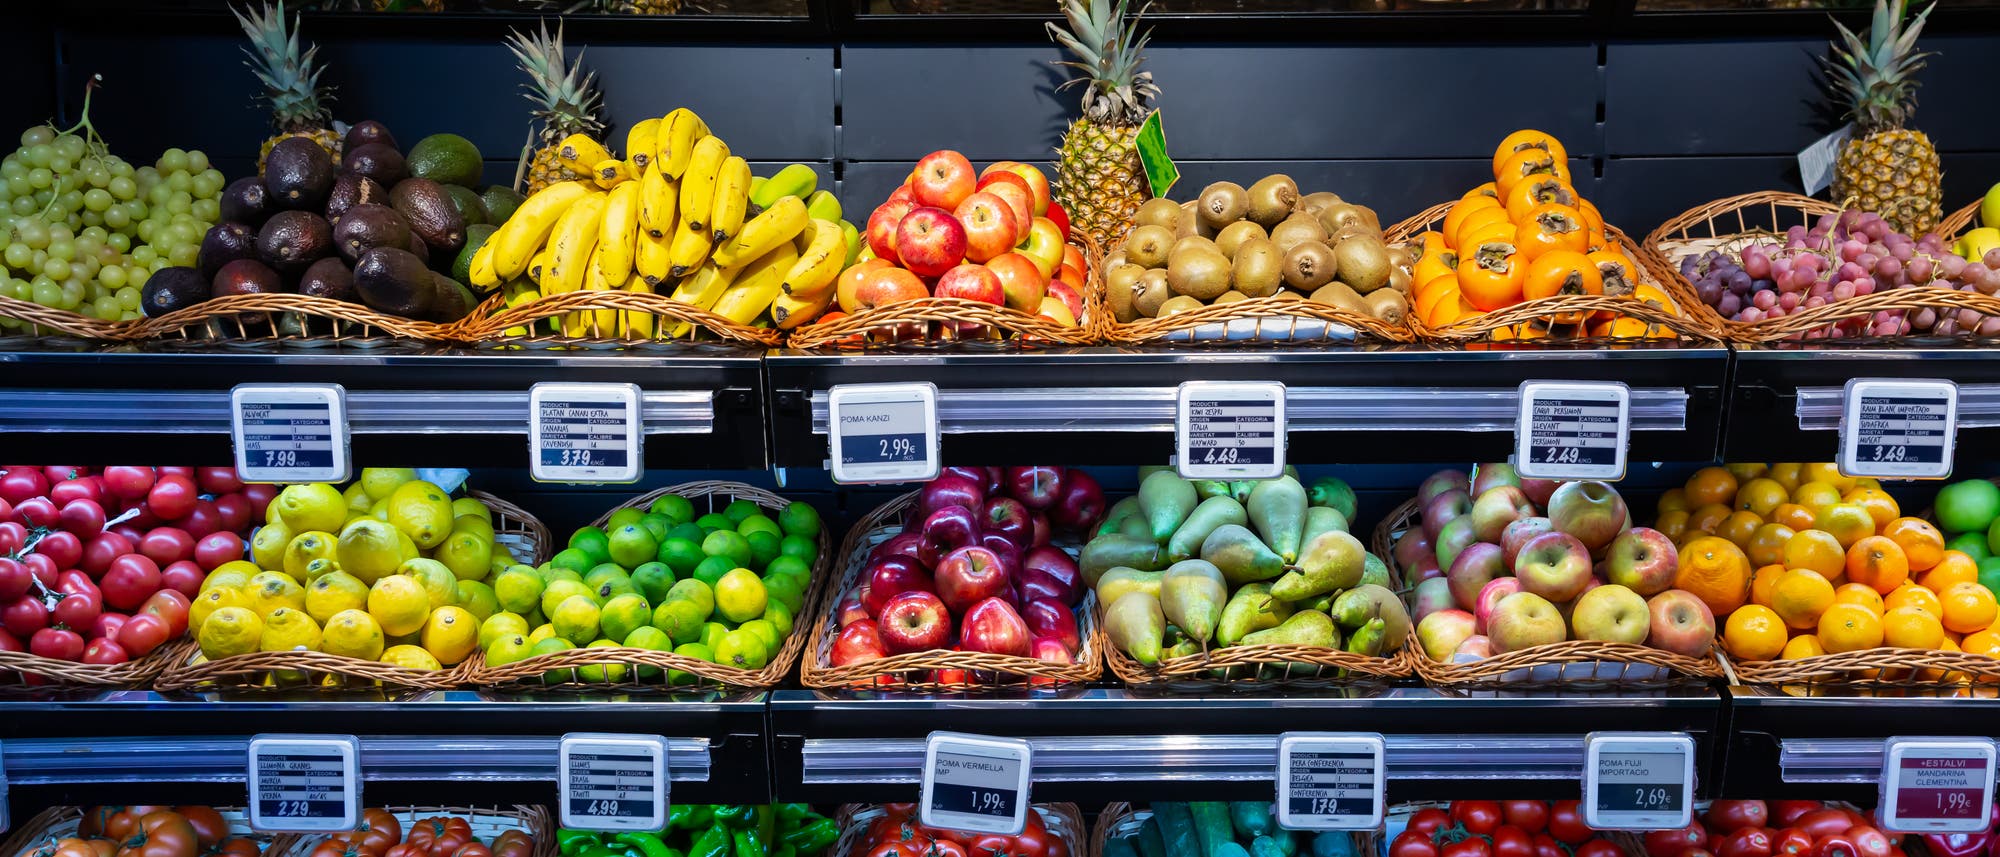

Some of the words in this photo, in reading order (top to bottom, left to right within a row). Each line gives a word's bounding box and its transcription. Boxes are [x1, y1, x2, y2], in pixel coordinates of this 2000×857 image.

[880, 439, 915, 459] 2,99€
[1204, 448, 1237, 464] 4,49
[1546, 448, 1579, 463] 2,49
[1873, 446, 1905, 461] 3,49
[265, 451, 296, 466] 7,99
[561, 450, 590, 465] 3,79
[936, 759, 960, 768] POMA
[962, 762, 1004, 772] VERMELLA
[971, 791, 1005, 812] 1,99€
[1636, 789, 1671, 808] 2,69€
[1937, 793, 1971, 814] 1,99€
[278, 802, 308, 816] 2,29
[588, 800, 618, 815] 4,99
[1312, 799, 1337, 814] 1,79
